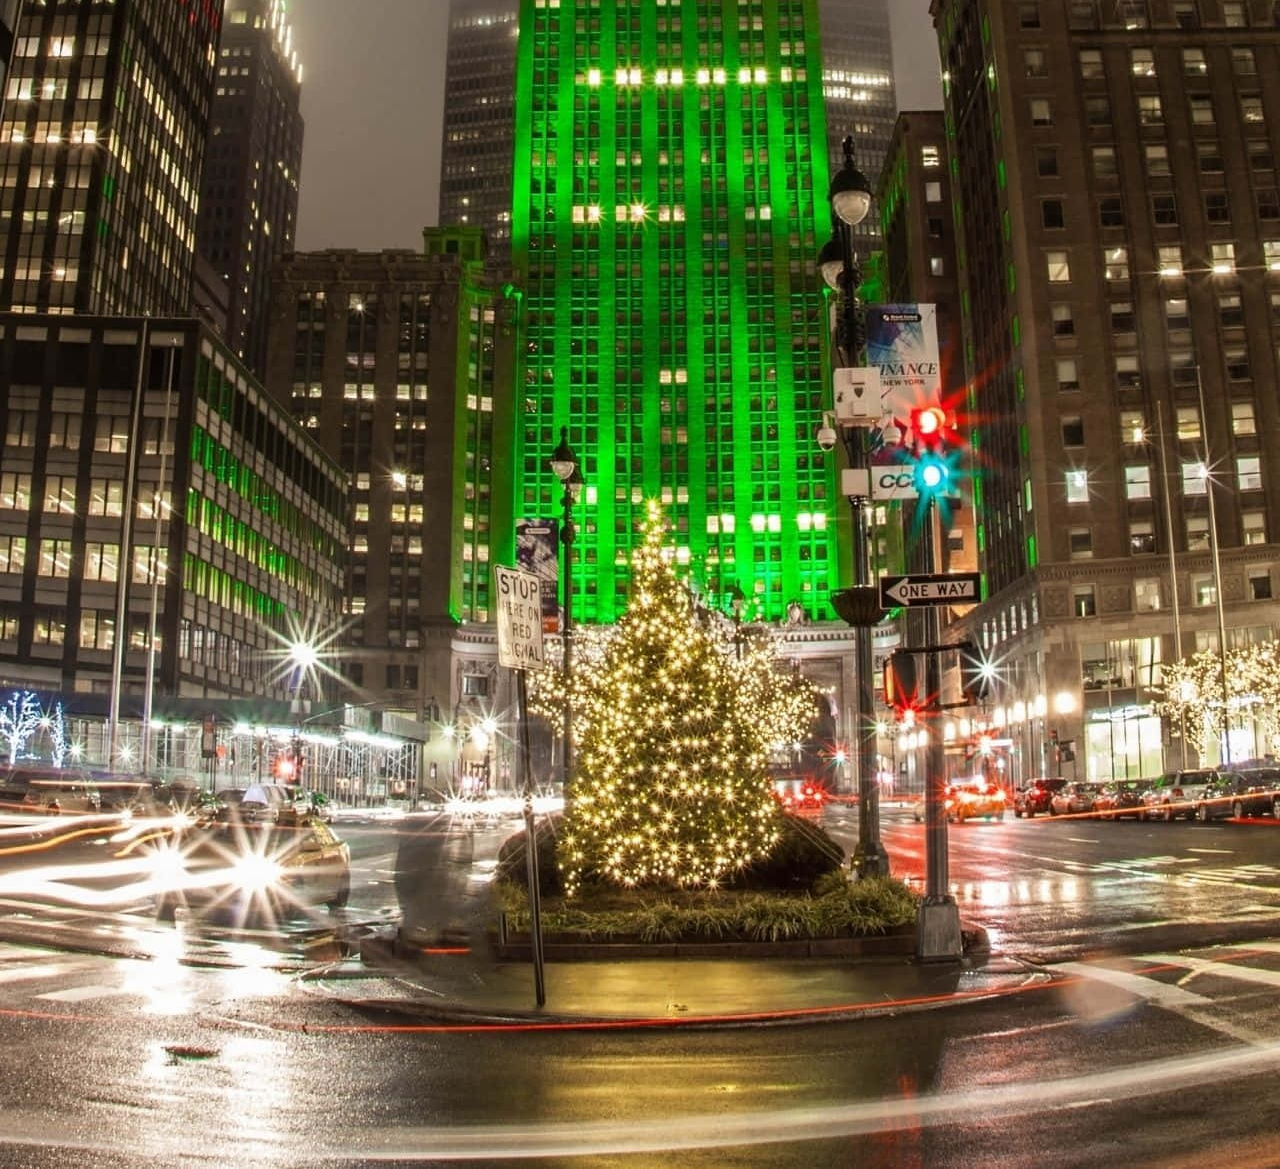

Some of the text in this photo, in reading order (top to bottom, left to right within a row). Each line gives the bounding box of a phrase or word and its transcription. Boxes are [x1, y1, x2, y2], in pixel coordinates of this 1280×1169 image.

[500, 574, 538, 601] STOP
[899, 582, 967, 599] ONE WAY
[528, 607, 539, 622] ON
[512, 622, 532, 640] RED
